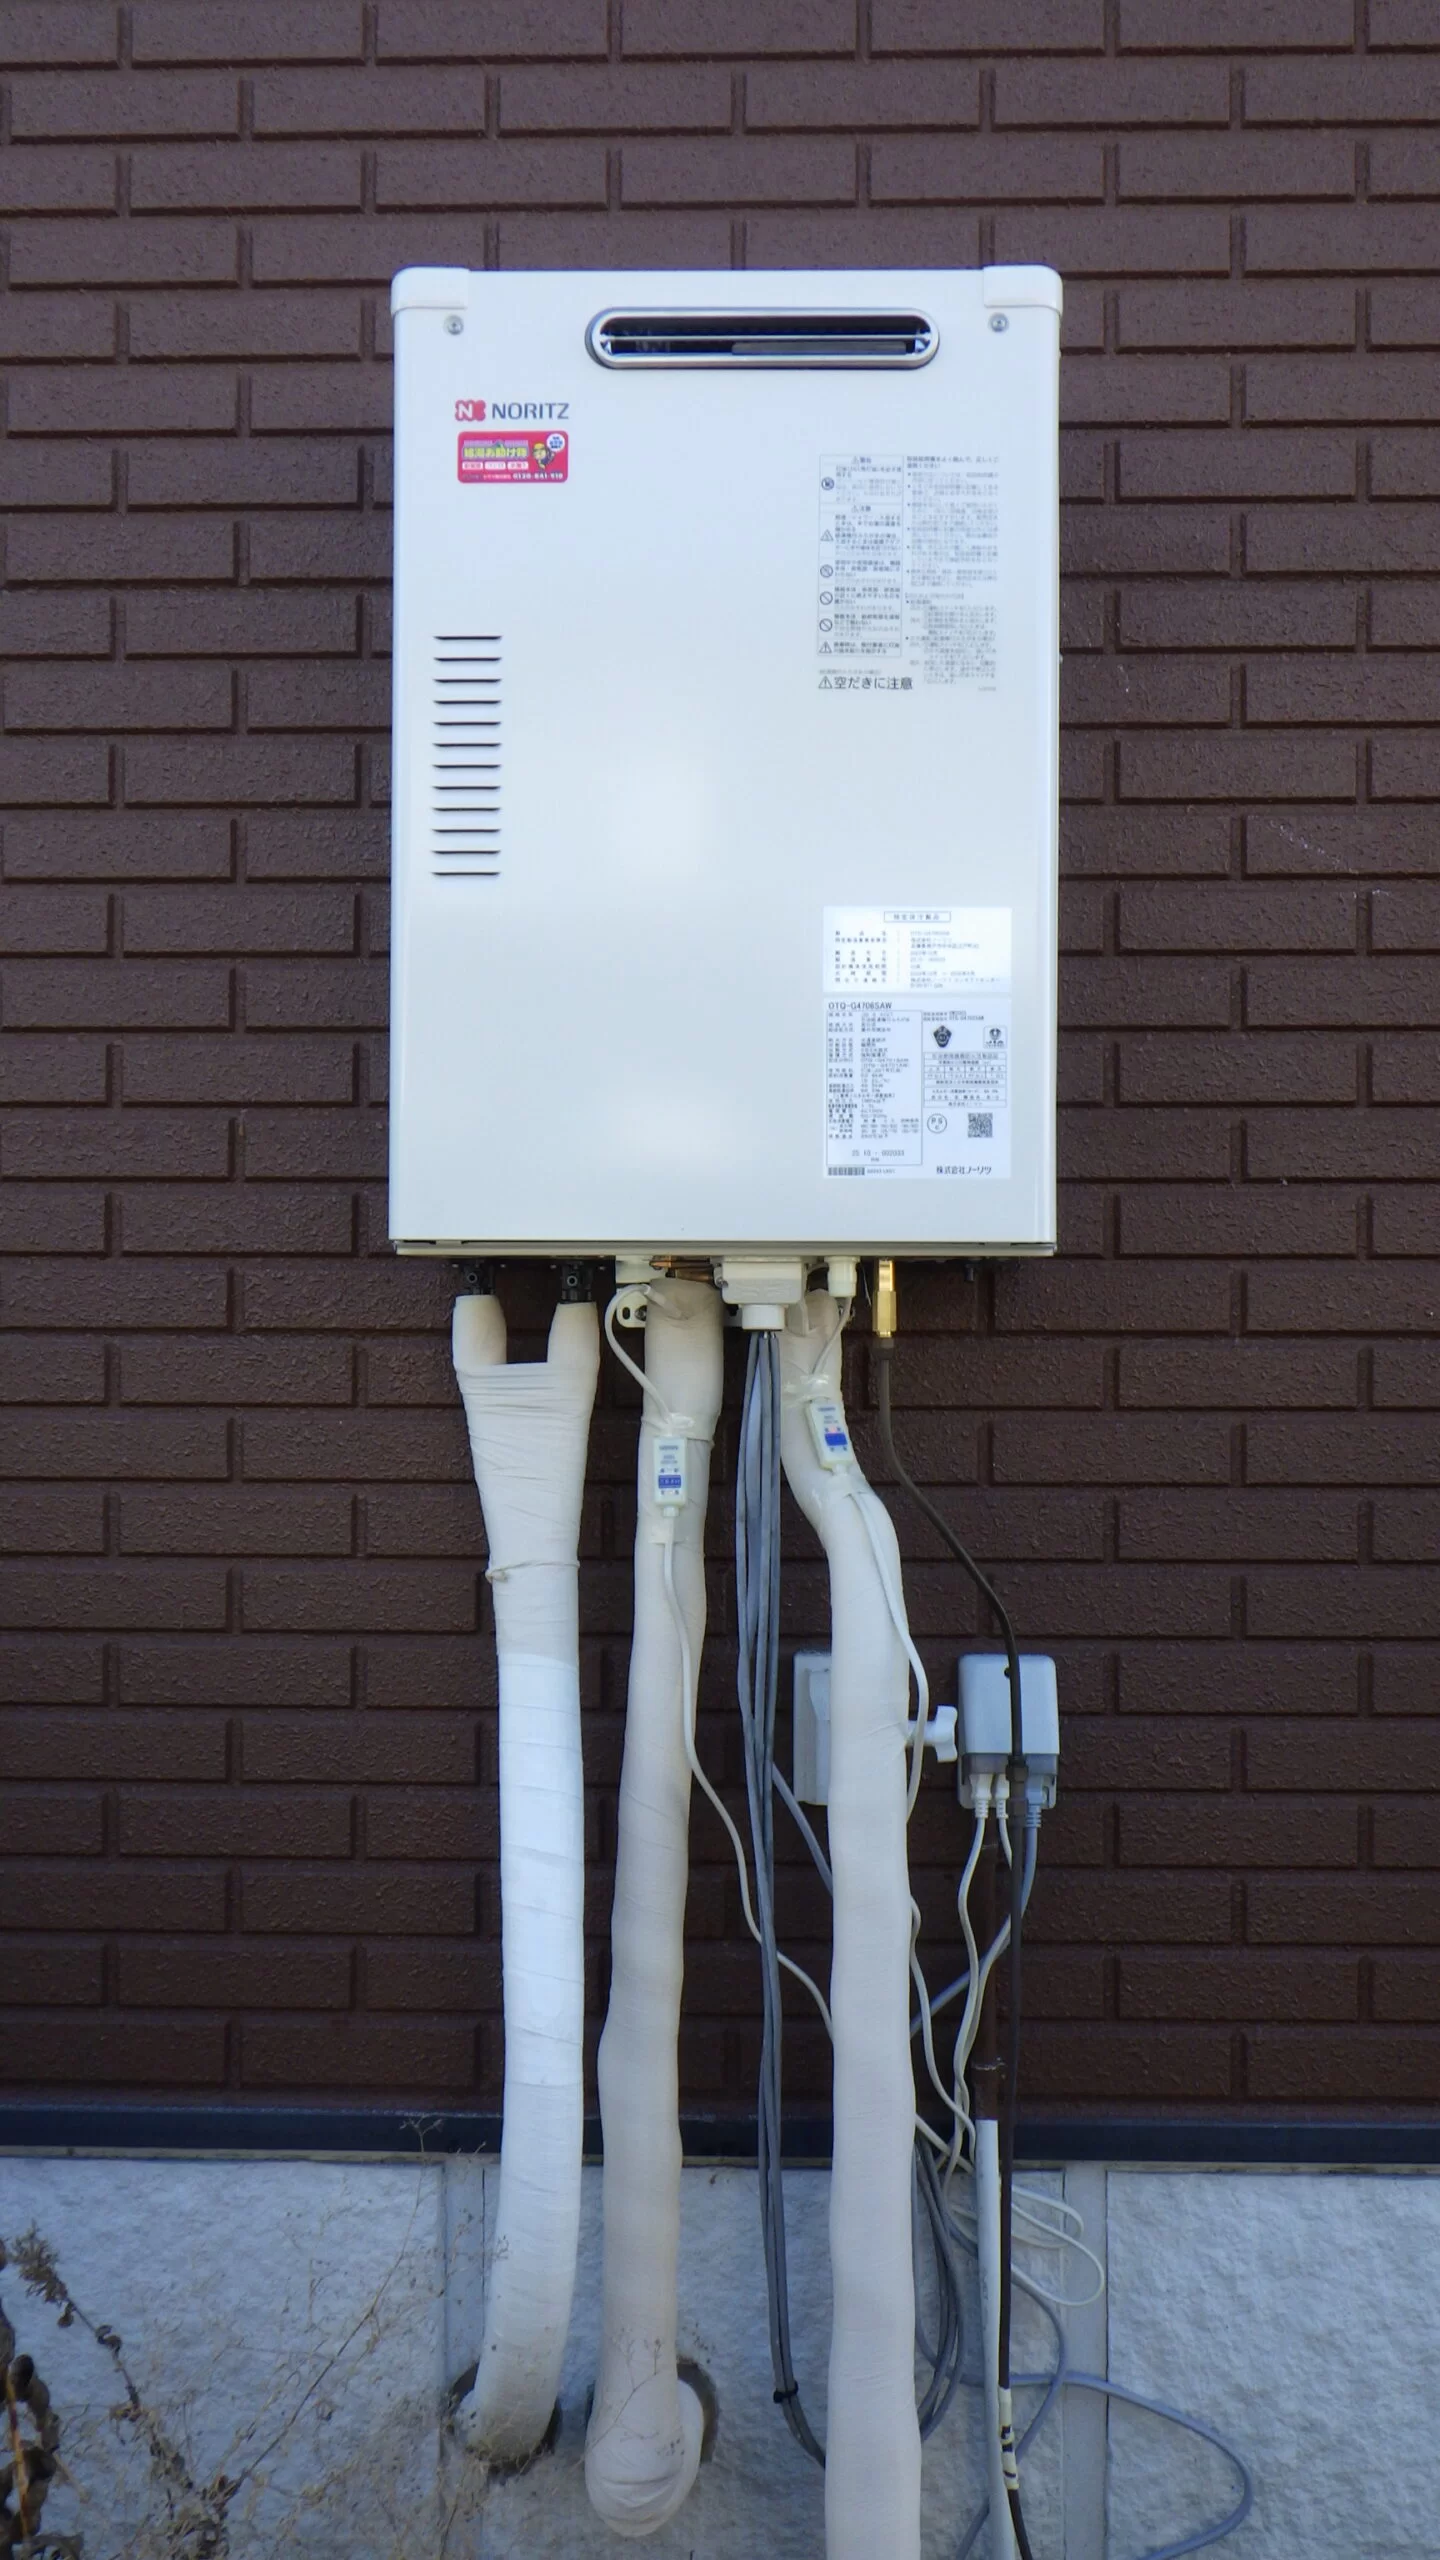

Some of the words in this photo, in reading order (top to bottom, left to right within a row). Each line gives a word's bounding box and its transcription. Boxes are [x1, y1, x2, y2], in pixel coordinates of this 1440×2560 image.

[491, 402, 570, 420] NORITZ
[834, 676, 913, 690] 空だきに注意
[936, 1166, 992, 1175] 株式会社ノーリツ
